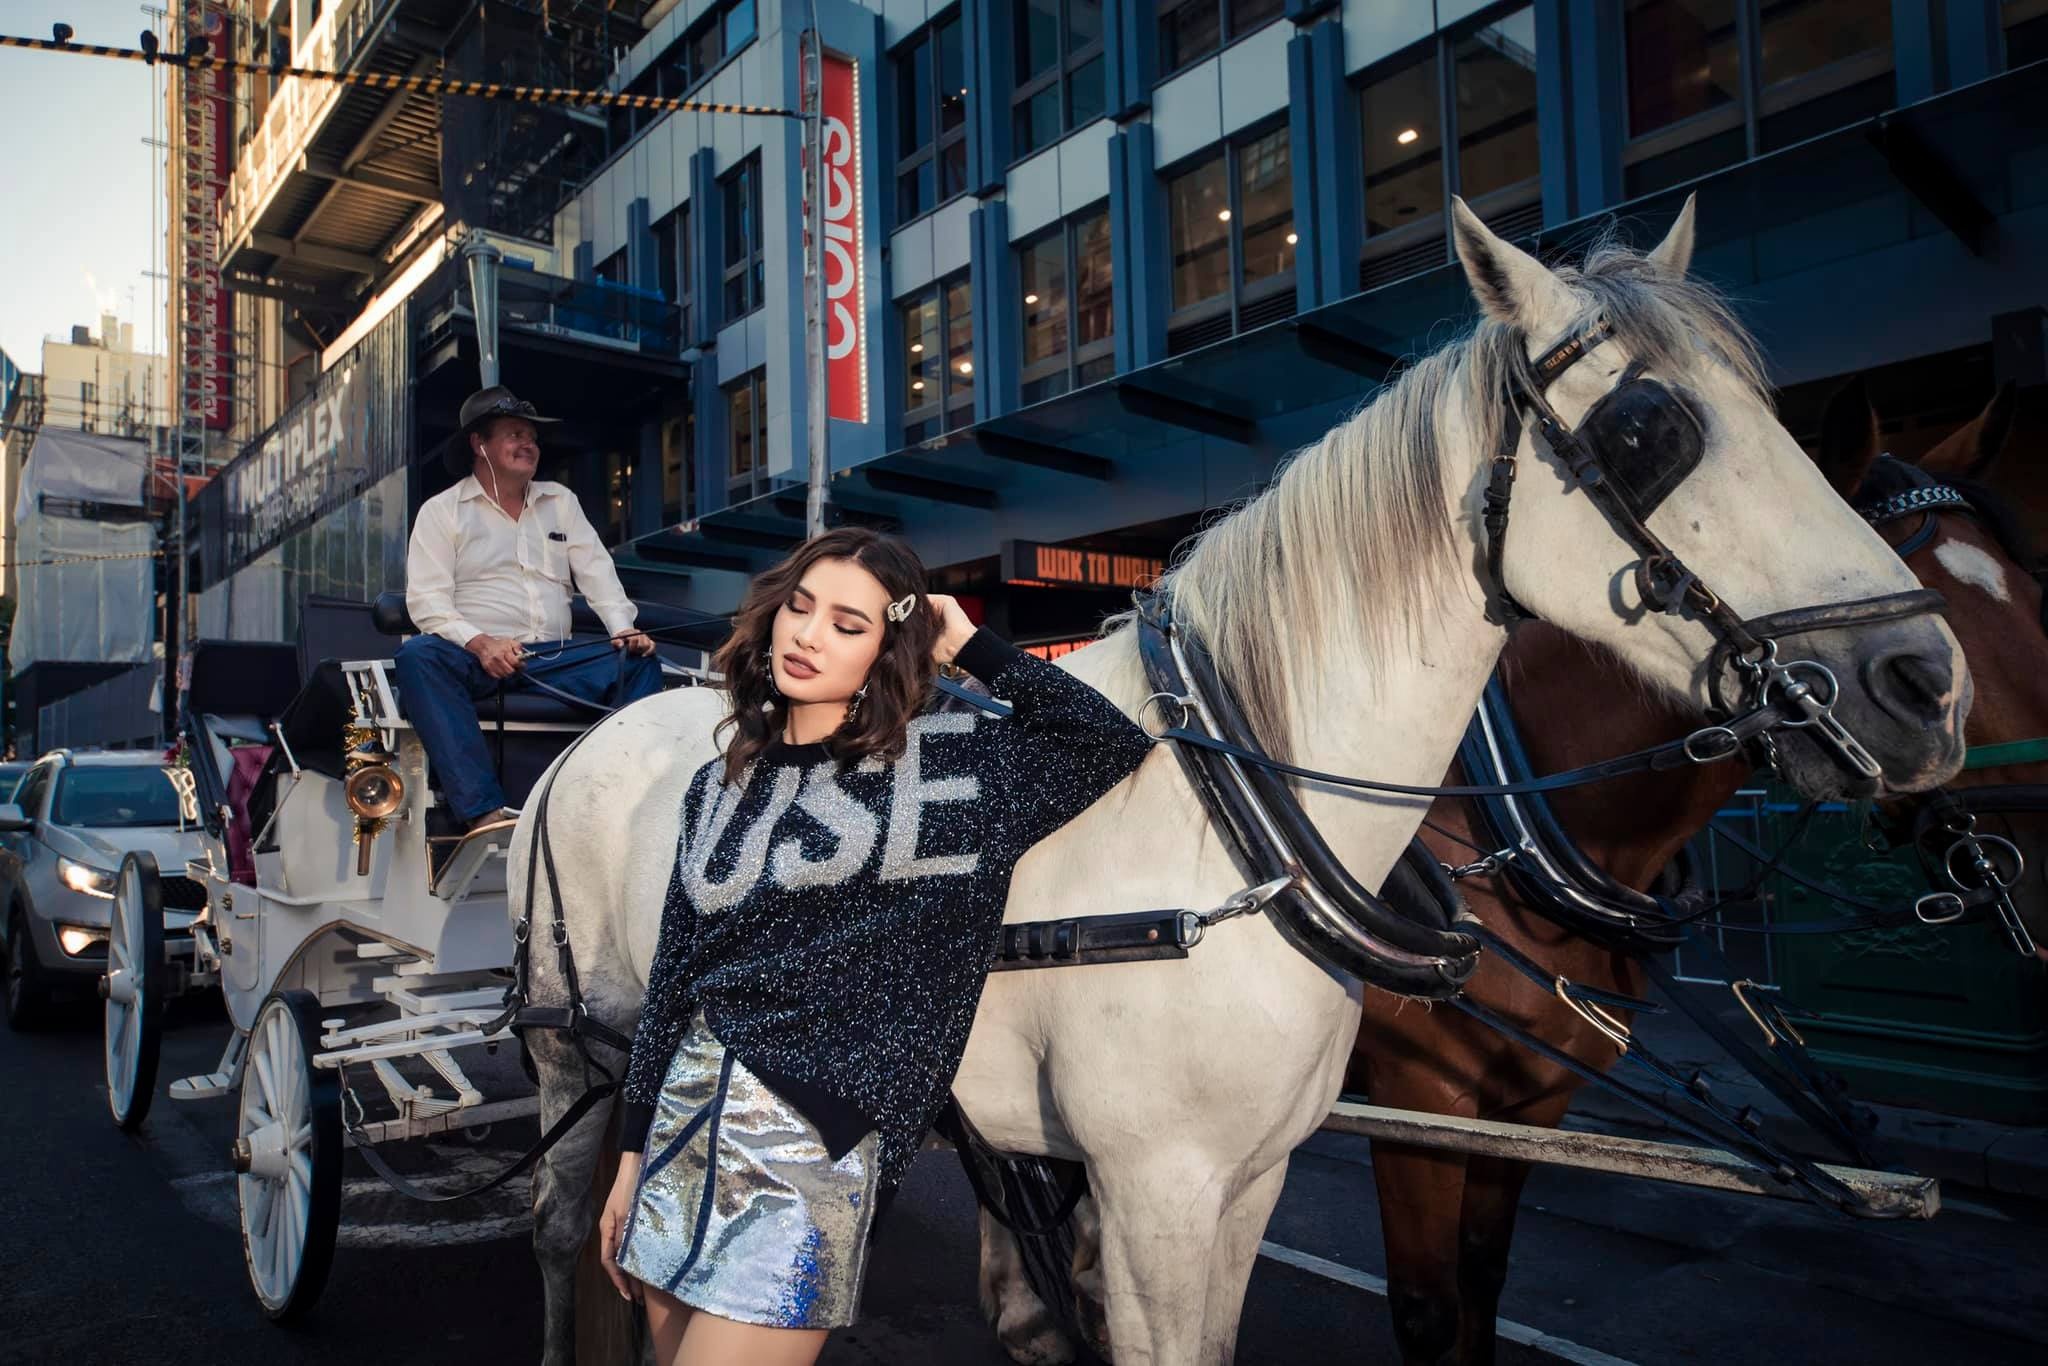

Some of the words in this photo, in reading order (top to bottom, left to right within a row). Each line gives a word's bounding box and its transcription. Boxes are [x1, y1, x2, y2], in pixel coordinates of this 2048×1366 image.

[240, 383, 346, 513] MULTIPLEX
[1036, 546, 1083, 583] WOK
[1087, 551, 1109, 585] TO
